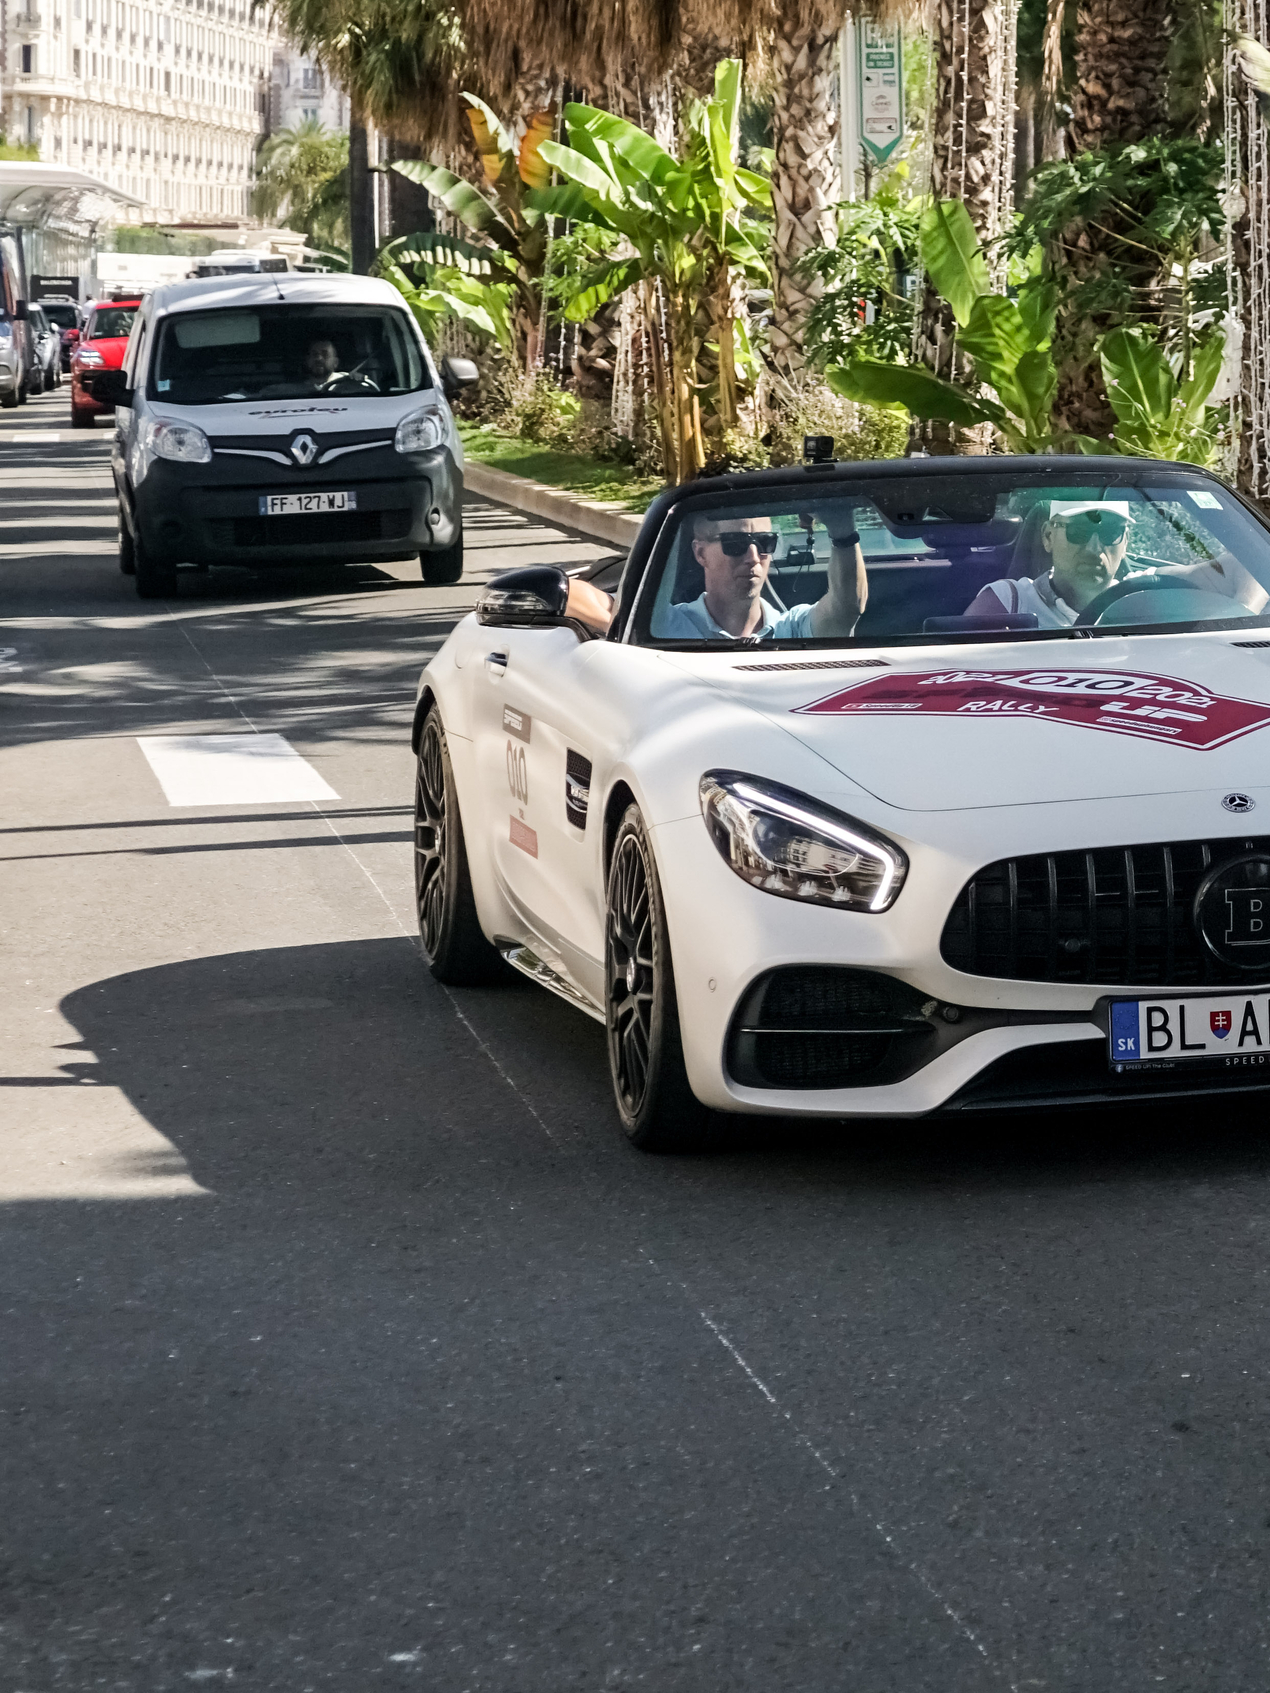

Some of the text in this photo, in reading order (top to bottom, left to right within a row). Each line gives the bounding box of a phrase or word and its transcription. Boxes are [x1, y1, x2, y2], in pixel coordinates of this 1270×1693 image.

[1018, 675, 1136, 691] 010
[1122, 685, 1218, 709] 2021
[956, 700, 1060, 713] RALLY
[506, 739, 529, 806] 010
[1146, 1004, 1207, 1053] BL
[1118, 1038, 1136, 1051] SK
[1225, 1056, 1265, 1066] SPEED
